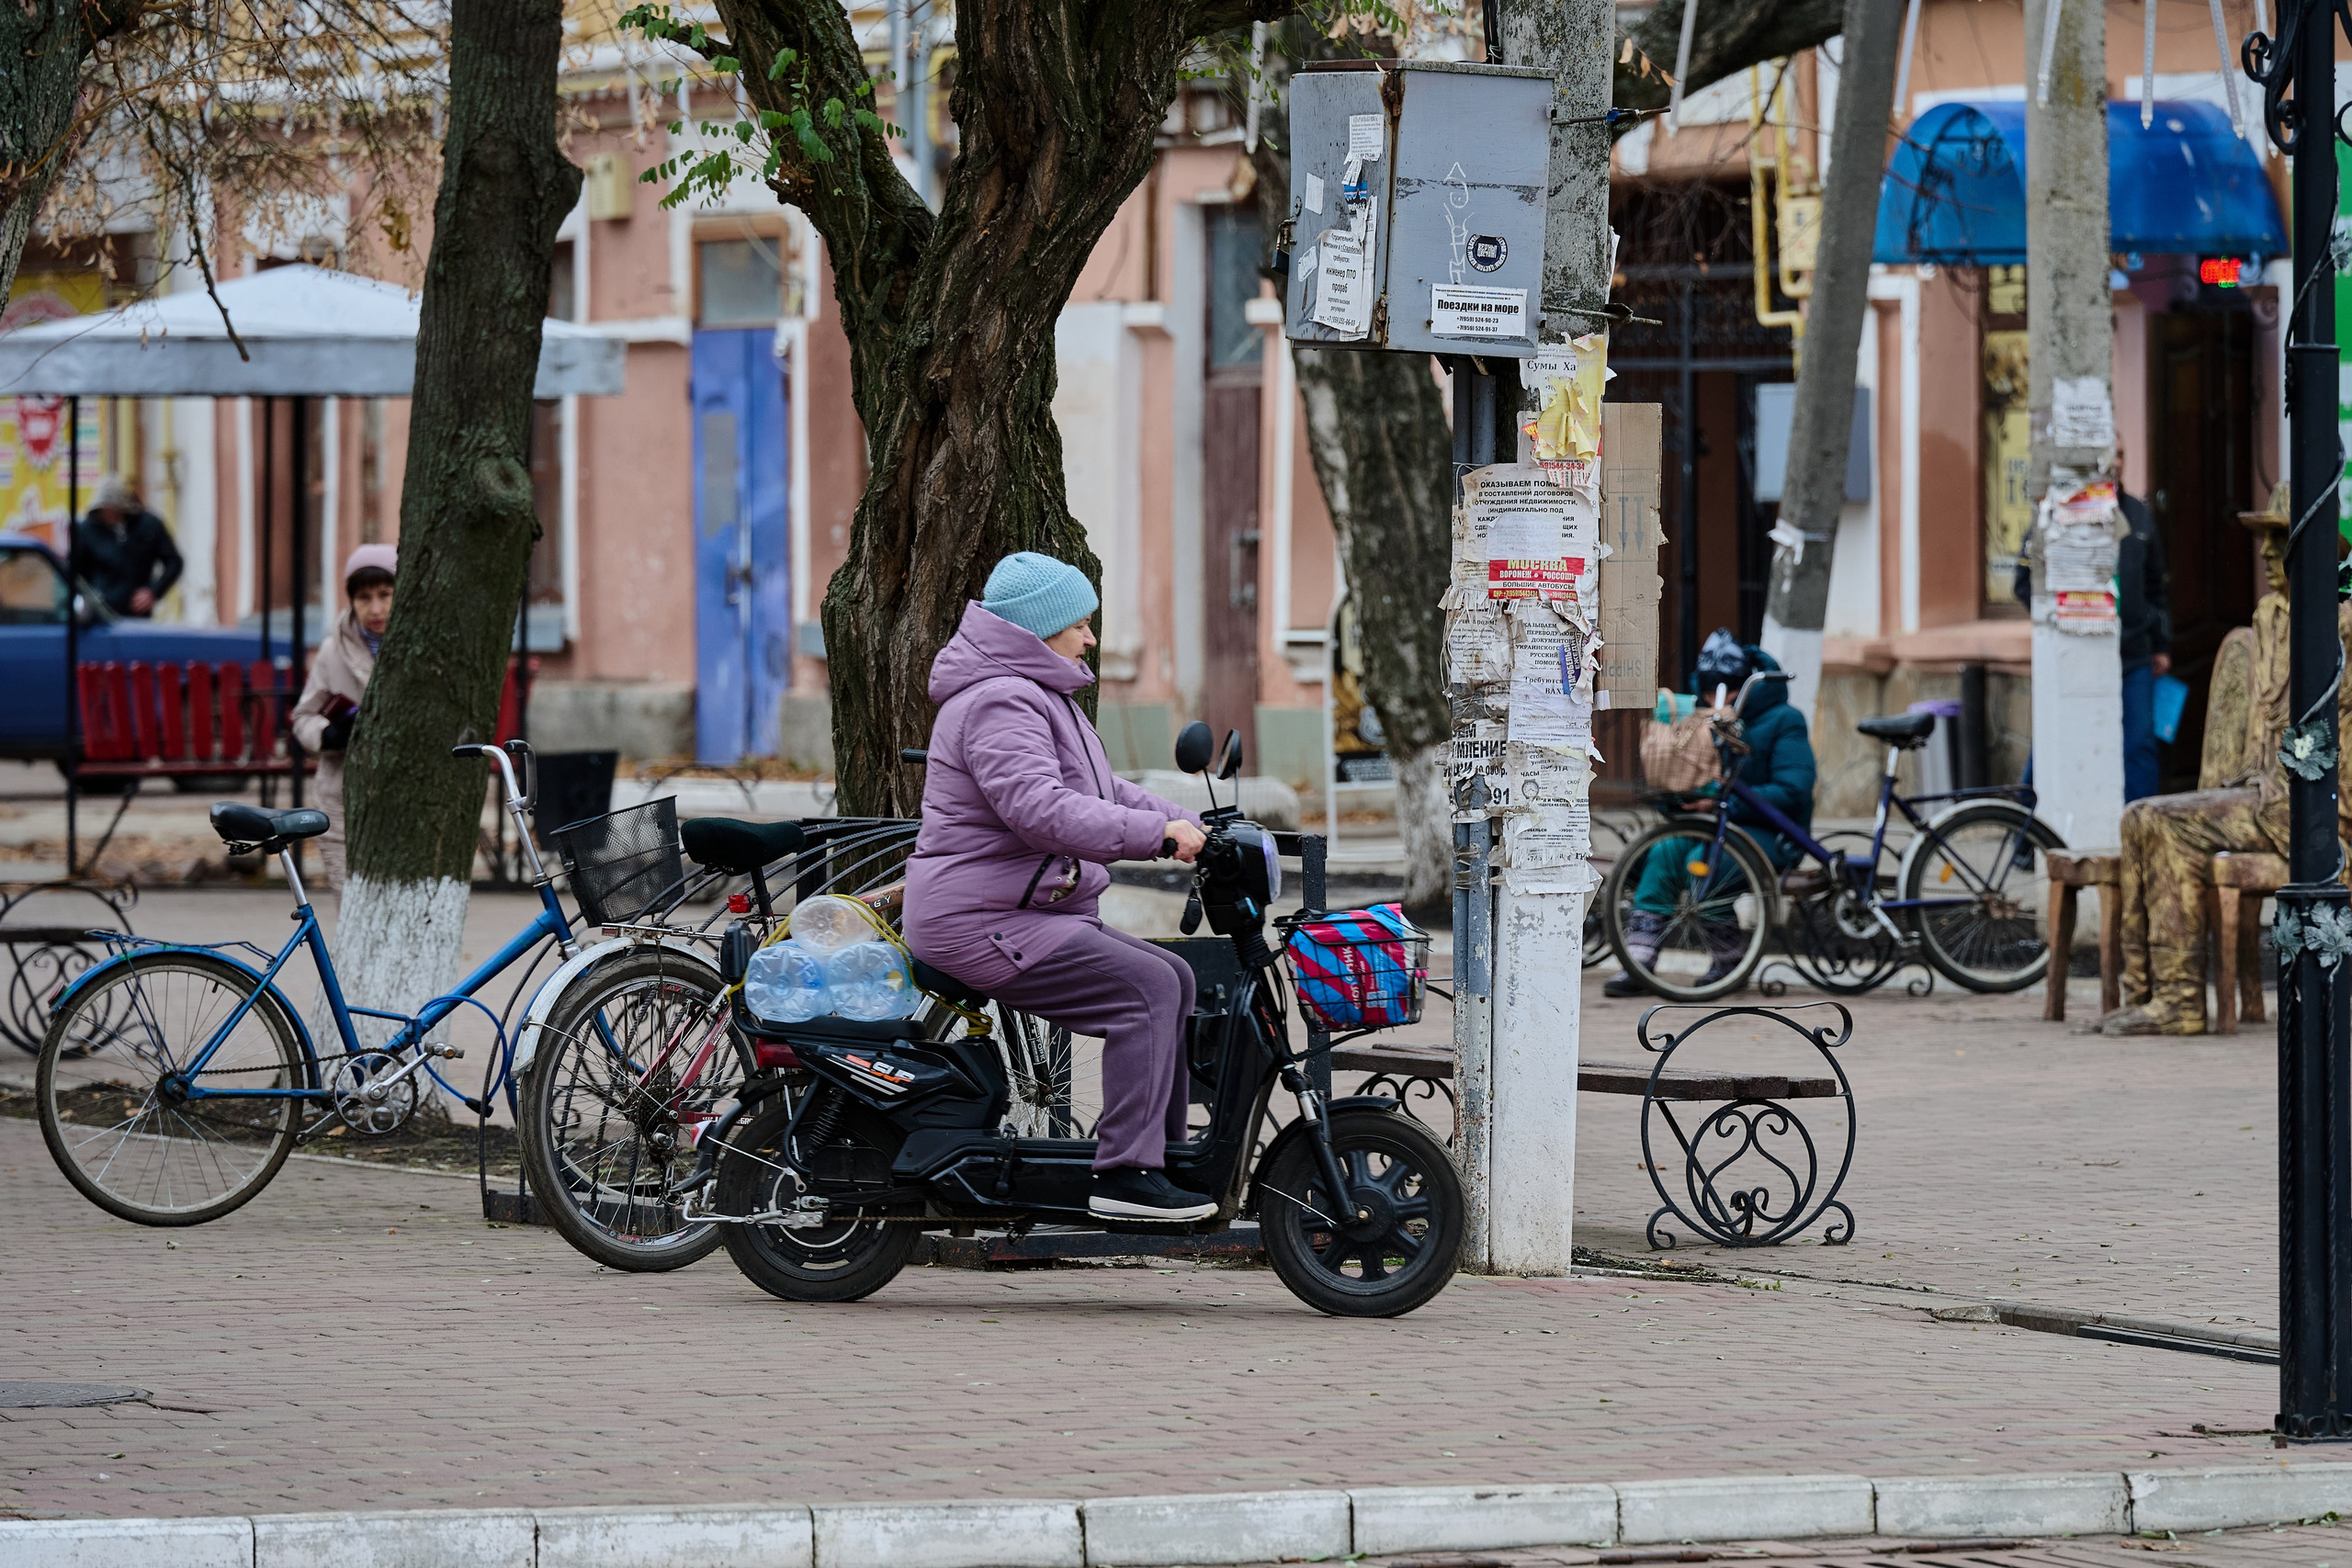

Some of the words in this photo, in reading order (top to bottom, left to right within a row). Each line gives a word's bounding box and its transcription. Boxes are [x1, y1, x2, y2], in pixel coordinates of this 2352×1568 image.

[1346, 268, 1357, 279] ПТО
[1331, 283, 1348, 294] прораб
[1437, 299, 1479, 312] Поездки
[1481, 303, 1493, 311] на
[1495, 304, 1520, 314] море
[1527, 359, 1557, 372] Сумы
[1563, 361, 1577, 371] Ха
[1507, 559, 1568, 571] МОСКВА
[1499, 570, 1532, 579] ВОРОНЕЖ
[1523, 675, 1564, 684] Требуются
